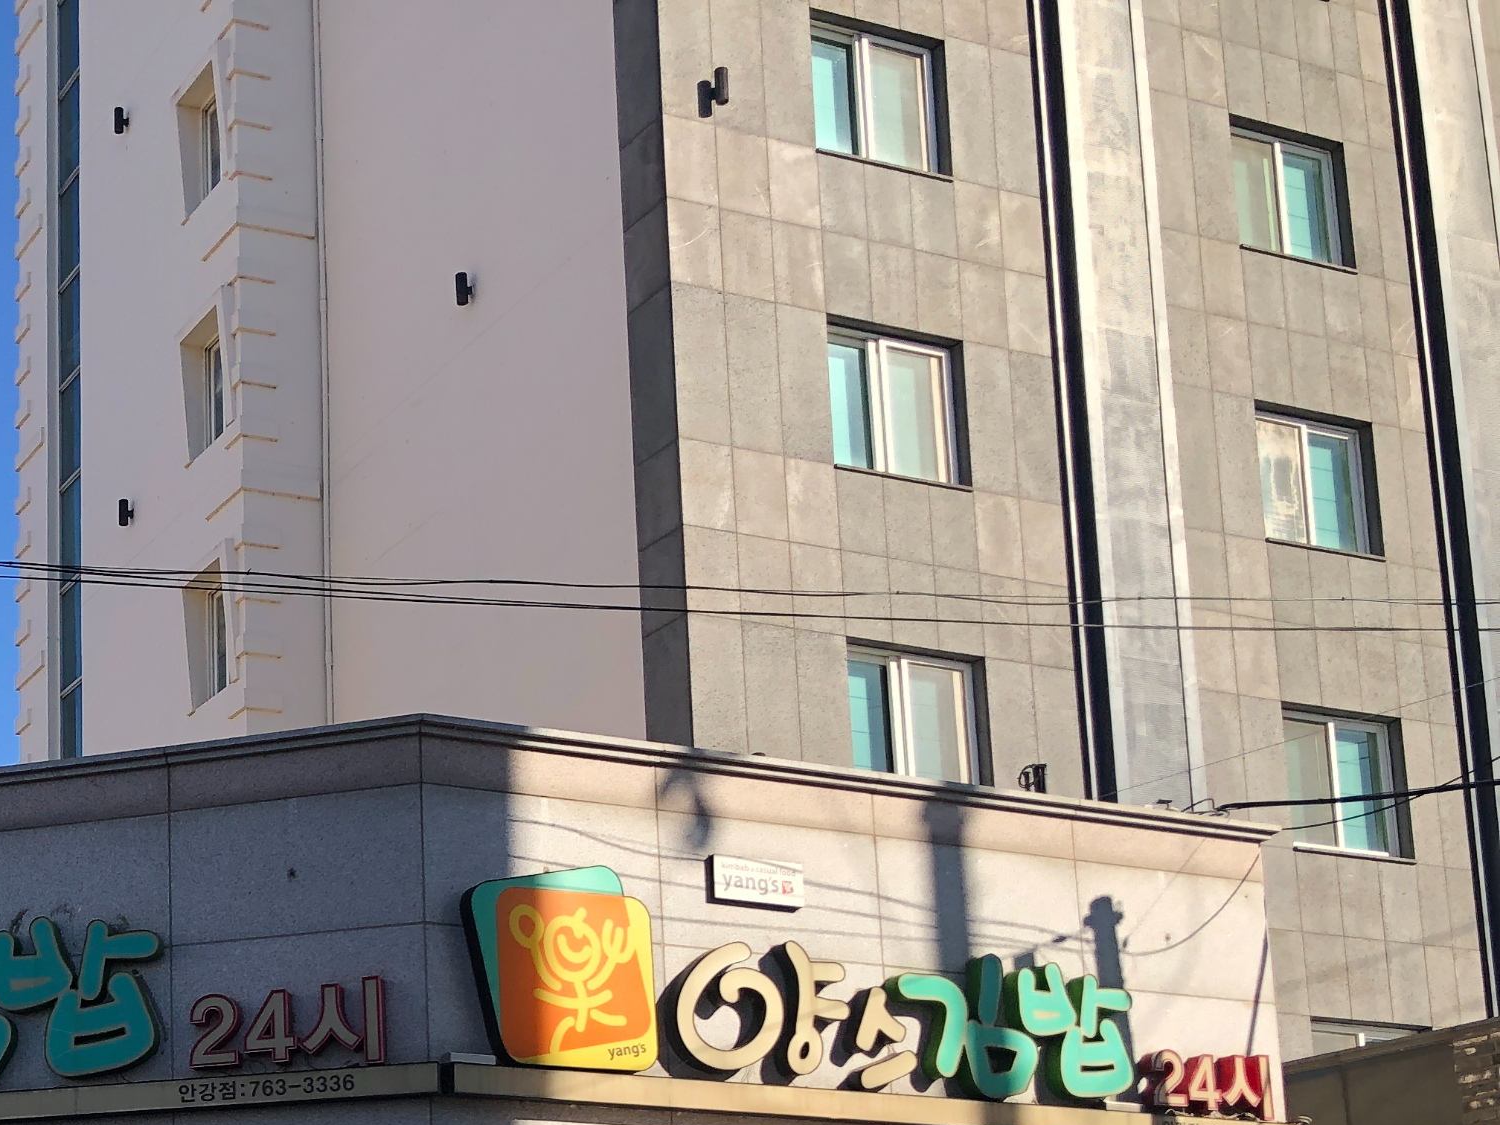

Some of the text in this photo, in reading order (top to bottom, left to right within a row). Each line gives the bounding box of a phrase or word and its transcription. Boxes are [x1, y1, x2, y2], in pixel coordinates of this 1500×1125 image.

[721, 861, 750, 871] kimbab
[755, 867, 778, 875] casual
[779, 867, 796, 877] food
[722, 873, 779, 896] yang's
[189, 976, 388, 1069] 24시
[607, 1042, 647, 1061] yang's
[1148, 1049, 1276, 1121] 24시
